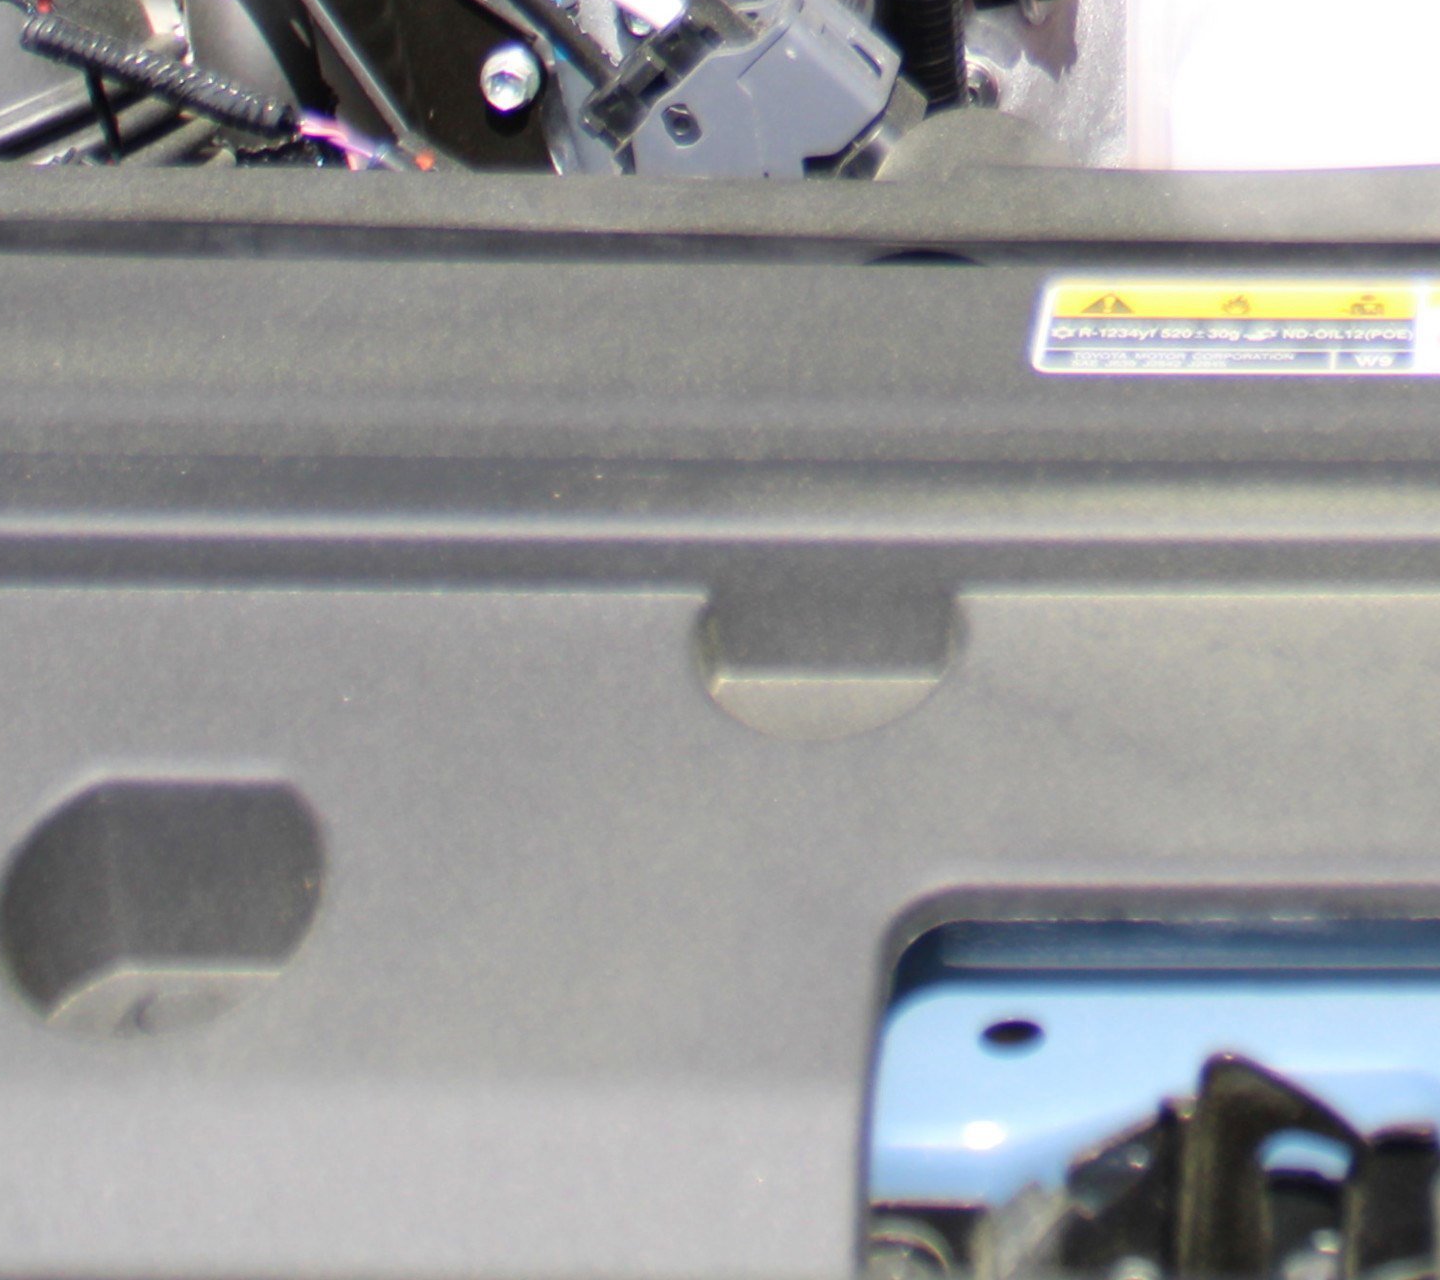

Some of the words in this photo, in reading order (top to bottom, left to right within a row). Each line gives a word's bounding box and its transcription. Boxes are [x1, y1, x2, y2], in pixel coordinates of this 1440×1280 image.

[1073, 351, 1128, 360] TOYOTA
[1135, 351, 1186, 360] MOTOR
[1191, 351, 1295, 360] CORPORATION
